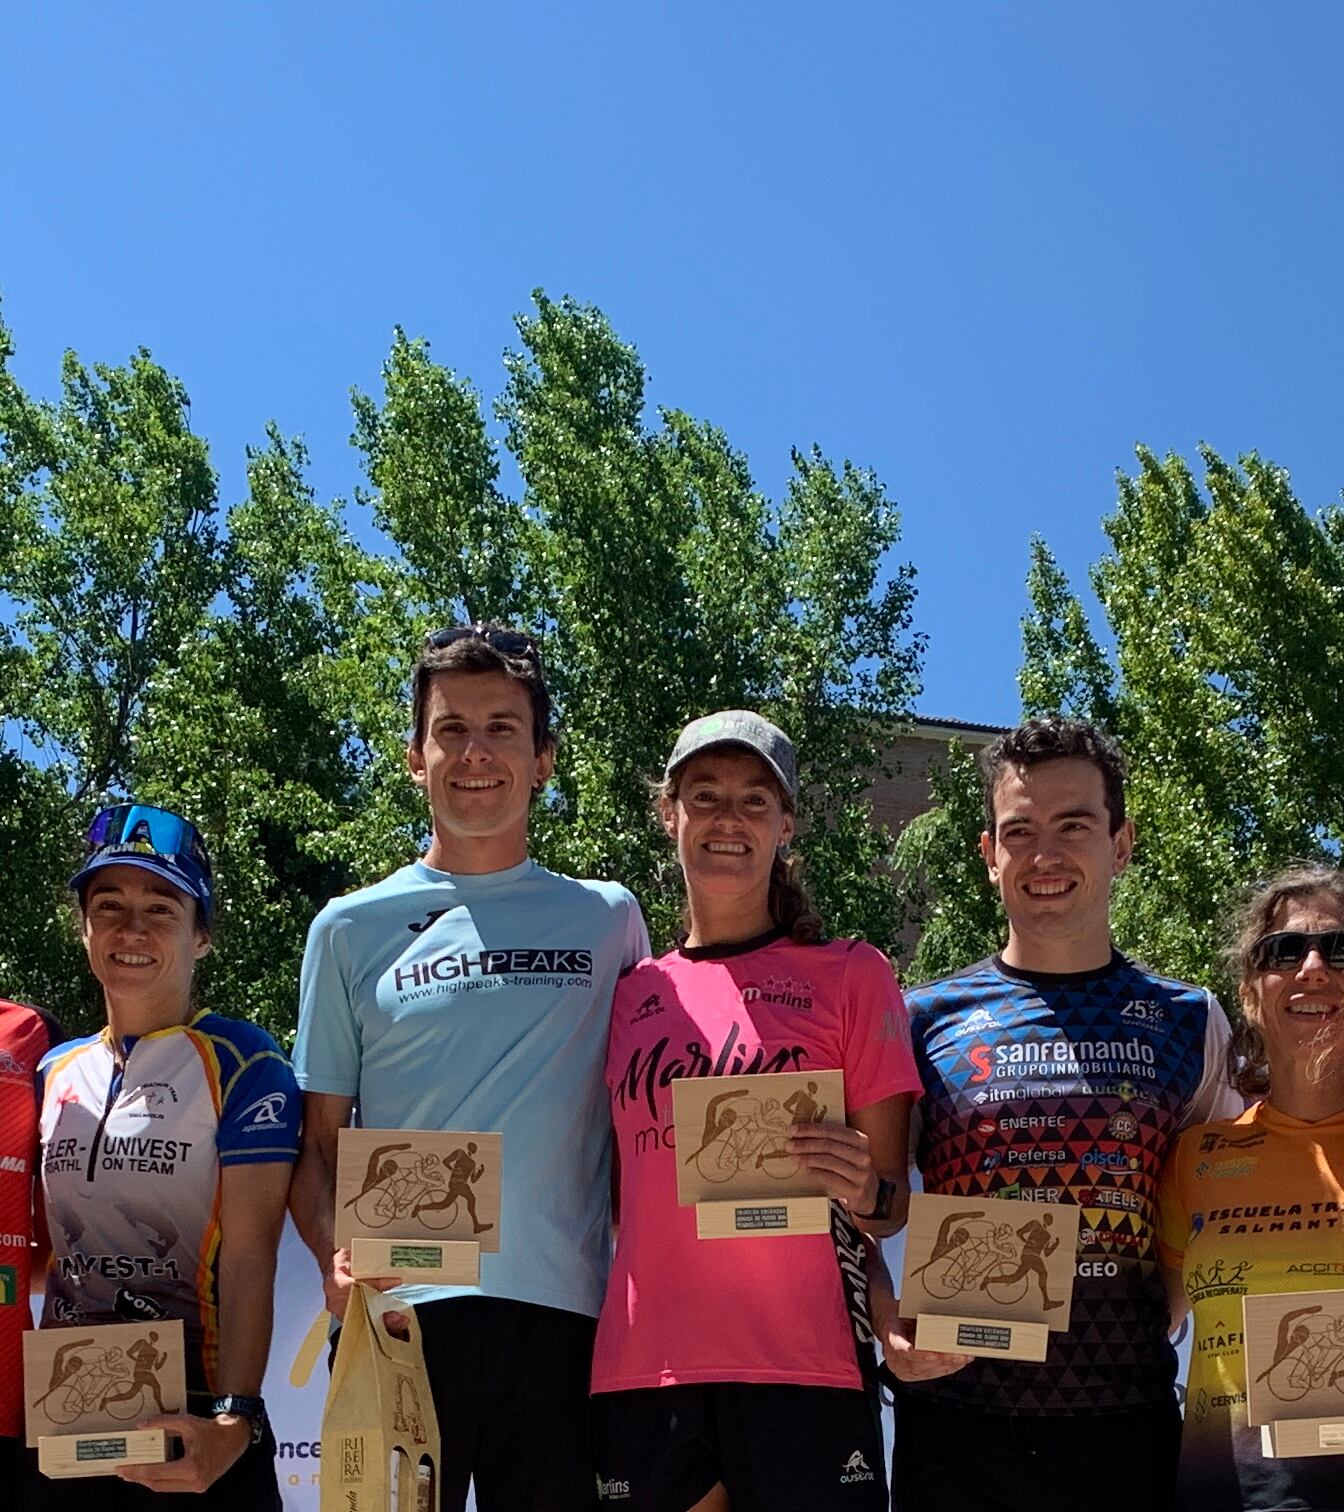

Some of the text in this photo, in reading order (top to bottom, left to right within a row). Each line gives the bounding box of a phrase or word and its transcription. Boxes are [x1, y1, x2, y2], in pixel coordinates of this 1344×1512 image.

[398, 975, 593, 1004] www.highpeaks-training.com
[996, 1038, 1155, 1065] sanfernando
[996, 1062, 1156, 1080] GRUPO INMOBILIARIO
[989, 1086, 1066, 1102] itmglobal
[1000, 1116, 1066, 1132] ENERTEC
[103, 1136, 192, 1162] UNIVEST
[1008, 1148, 1066, 1164] Pefersa
[102, 1158, 175, 1176] ON TEAM
[1209, 1203, 1302, 1221] ESCUELA
[1073, 1261, 1119, 1278] GEO
[1198, 1332, 1244, 1351] LTAFI
[1210, 1391, 1248, 1409] CERVIS
